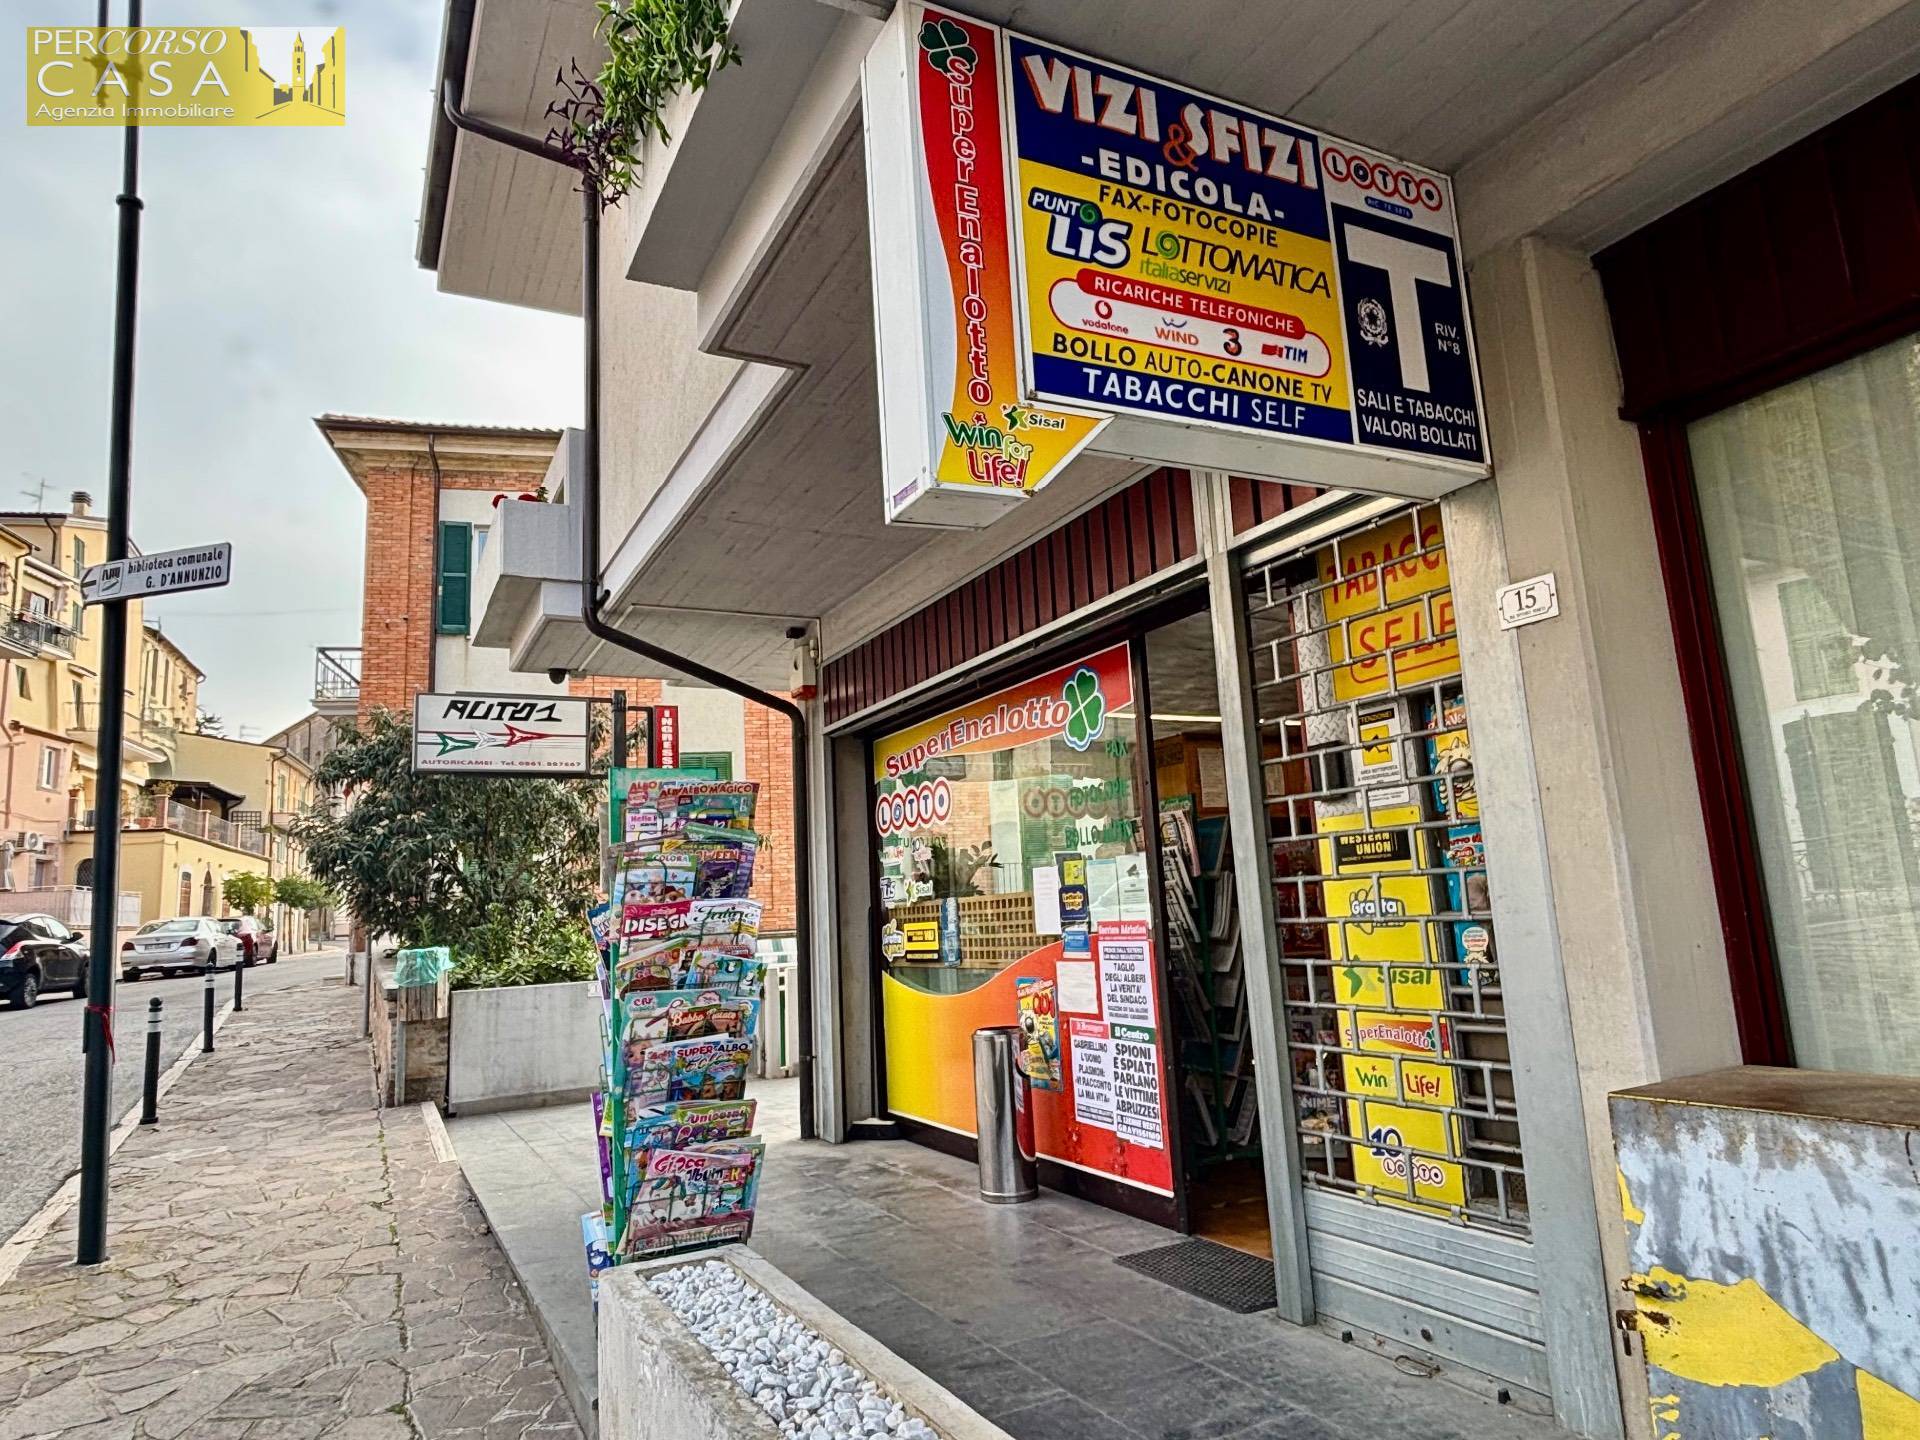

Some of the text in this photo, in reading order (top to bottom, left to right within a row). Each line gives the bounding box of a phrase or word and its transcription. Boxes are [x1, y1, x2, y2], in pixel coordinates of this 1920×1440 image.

[1020, 54, 1319, 190] VIZI & SFIZI
[1081, 147, 1285, 222] -EDICOLA-
[1323, 149, 1442, 210] LOTTO
[1099, 184, 1279, 248] FAX-FOTOCOPIE
[946, 56, 992, 405] SuperEnalotto
[1141, 225, 1332, 298] LOTTOMATICA
[1094, 276, 1296, 333] RICARICHE TELEFONICHE
[1343, 221, 1452, 393] T
[1082, 317, 1129, 334] vodafone
[1154, 326, 1200, 346] WIND
[1434, 322, 1460, 340] RIV.
[1222, 327, 1243, 357] 3
[1283, 344, 1308, 364] TIM
[1052, 332, 1333, 403] BOLLO AUTO-CANONE TV
[1082, 366, 1306, 429] TABACCHI SELF
[1357, 387, 1476, 428] SALI E TABACCHI
[943, 412, 1002, 448] Win
[1028, 413, 1066, 429] Sisal
[1362, 413, 1477, 451] VALORI BOLLATI
[1002, 434, 1033, 461] for
[967, 449, 1030, 487] Life!
[127, 547, 224, 575] biblioteca comunale
[1326, 523, 1447, 605] TABACC
[145, 565, 222, 588] G. D'ANNUNZIO
[1514, 586, 1537, 611] 15
[883, 697, 1072, 779] SuperEnalotto
[877, 779, 951, 834] LOTTO
[1356, 841, 1392, 855] UNION
[1351, 898, 1398, 915] Grata
[1104, 972, 1147, 983] DEGLI ALBERI
[1113, 962, 1136, 973] TAGLIO
[1106, 993, 1148, 1006] DEL SINDACO
[1109, 983, 1118, 993] LA
[1121, 1027, 1150, 1041] Centro
[1345, 1025, 1431, 1049] SperEnalotto
[676, 1045, 714, 1058] SUPER
[1115, 1042, 1152, 1060] SPIONI
[1113, 1056, 1157, 1075] E SPIATI
[1113, 1070, 1158, 1091] PARLANO
[1355, 1066, 1441, 1098] Win Life!
[1114, 1084, 1159, 1105] LE VITTIME
[1116, 1098, 1160, 1120] ABRUZZESI
[1371, 1127, 1403, 1158] 10
[1382, 1157, 1444, 1185] LOTO
